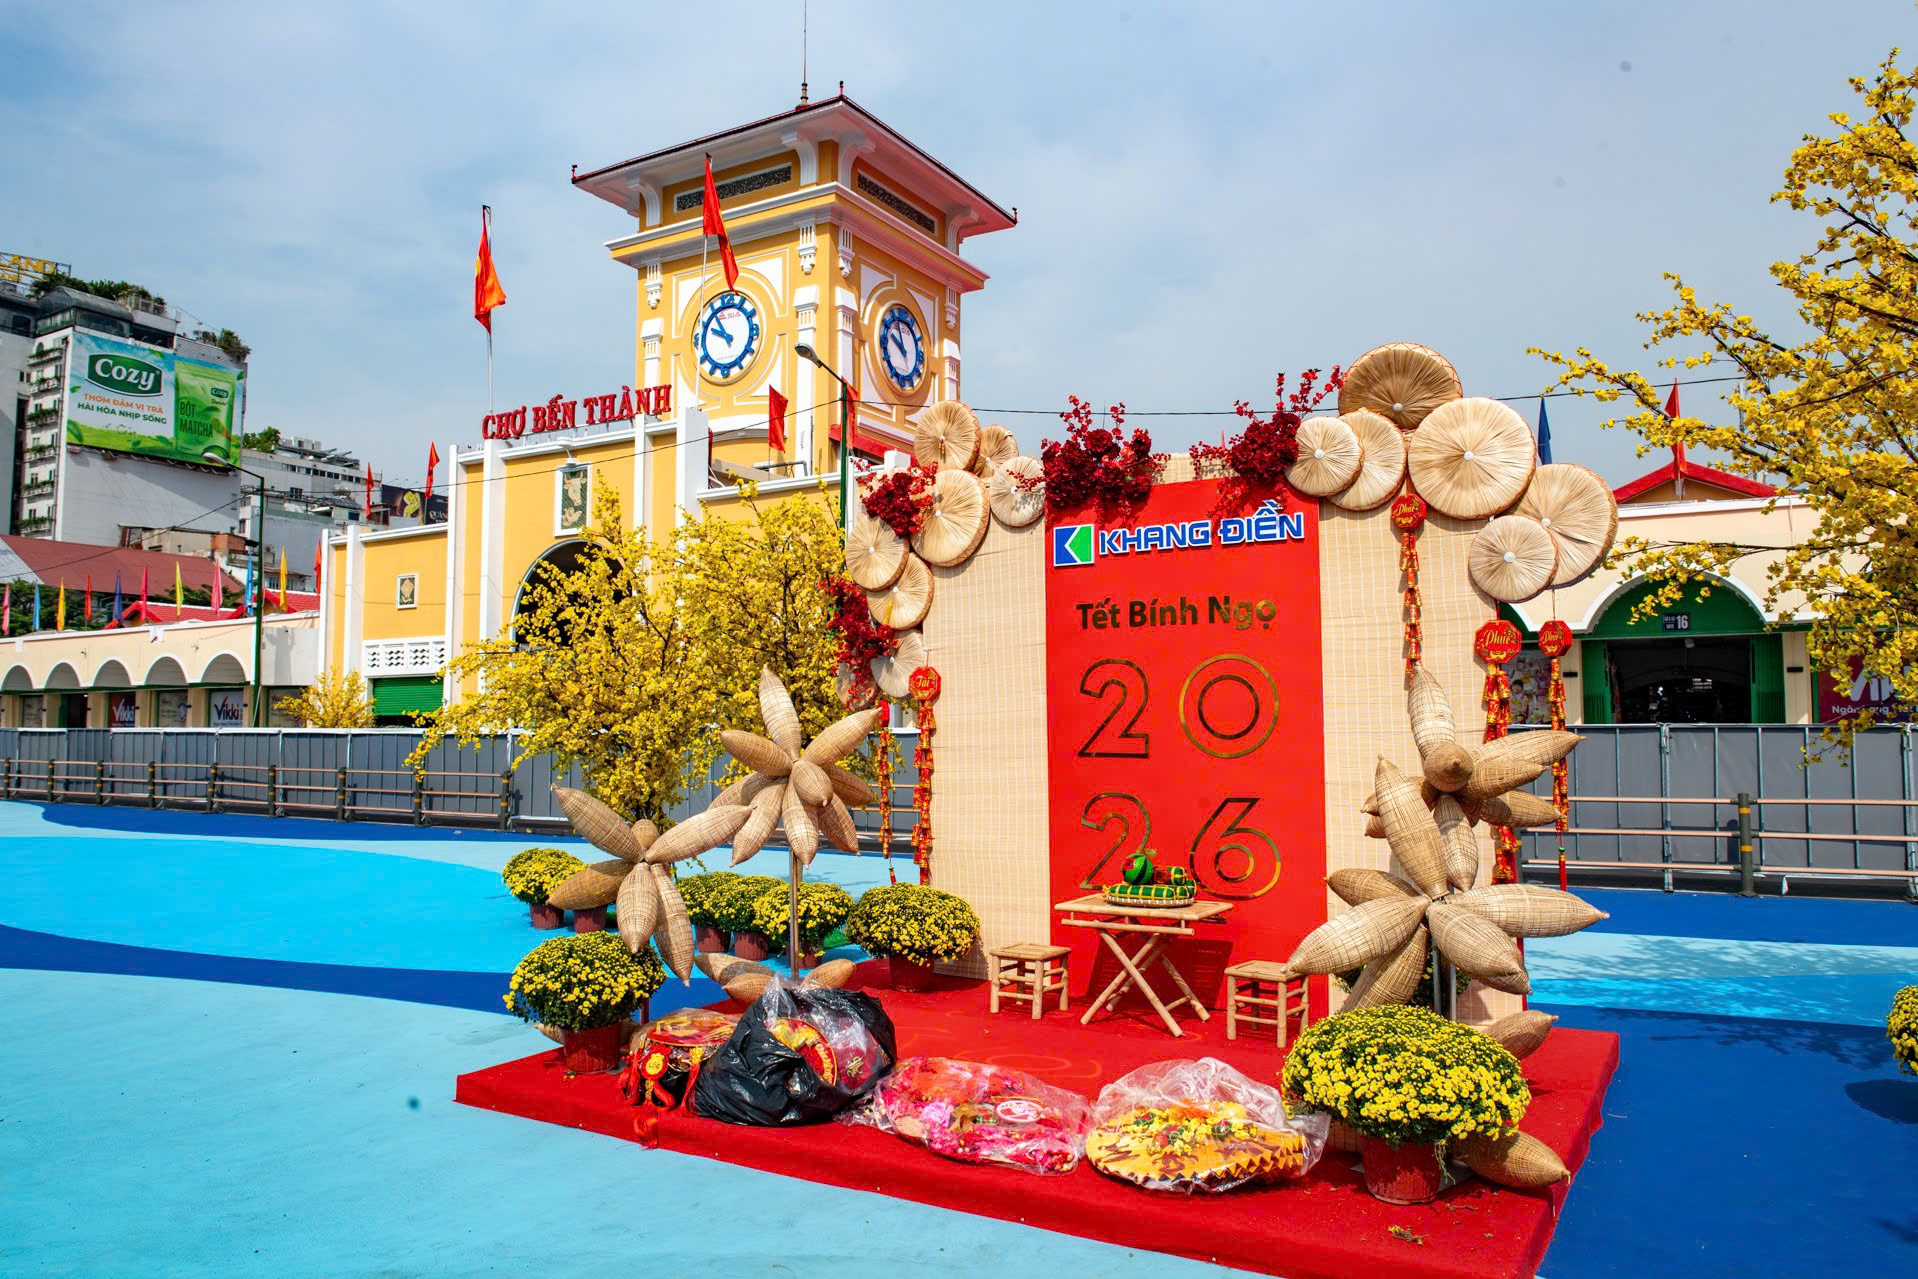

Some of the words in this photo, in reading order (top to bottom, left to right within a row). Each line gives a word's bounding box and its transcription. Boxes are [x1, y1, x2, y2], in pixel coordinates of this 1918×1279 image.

[95, 358, 155, 391] Cozy
[77, 402, 94, 411] HÀI
[118, 409, 141, 420] NHỊP
[481, 405, 527, 440] CHỢ
[532, 394, 577, 433] BẾN
[583, 384, 672, 425] THÀNH
[179, 418, 214, 438] MATCHA
[1099, 520, 1212, 555] KHANG
[1219, 499, 1305, 545] ĐIỀN
[1075, 597, 1121, 629] Tết
[1129, 596, 1198, 627] Bính
[1208, 595, 1276, 630] Ngọ
[1676, 614, 1689, 630] 16
[112, 698, 134, 722] Vikki
[214, 695, 240, 721] Vikki
